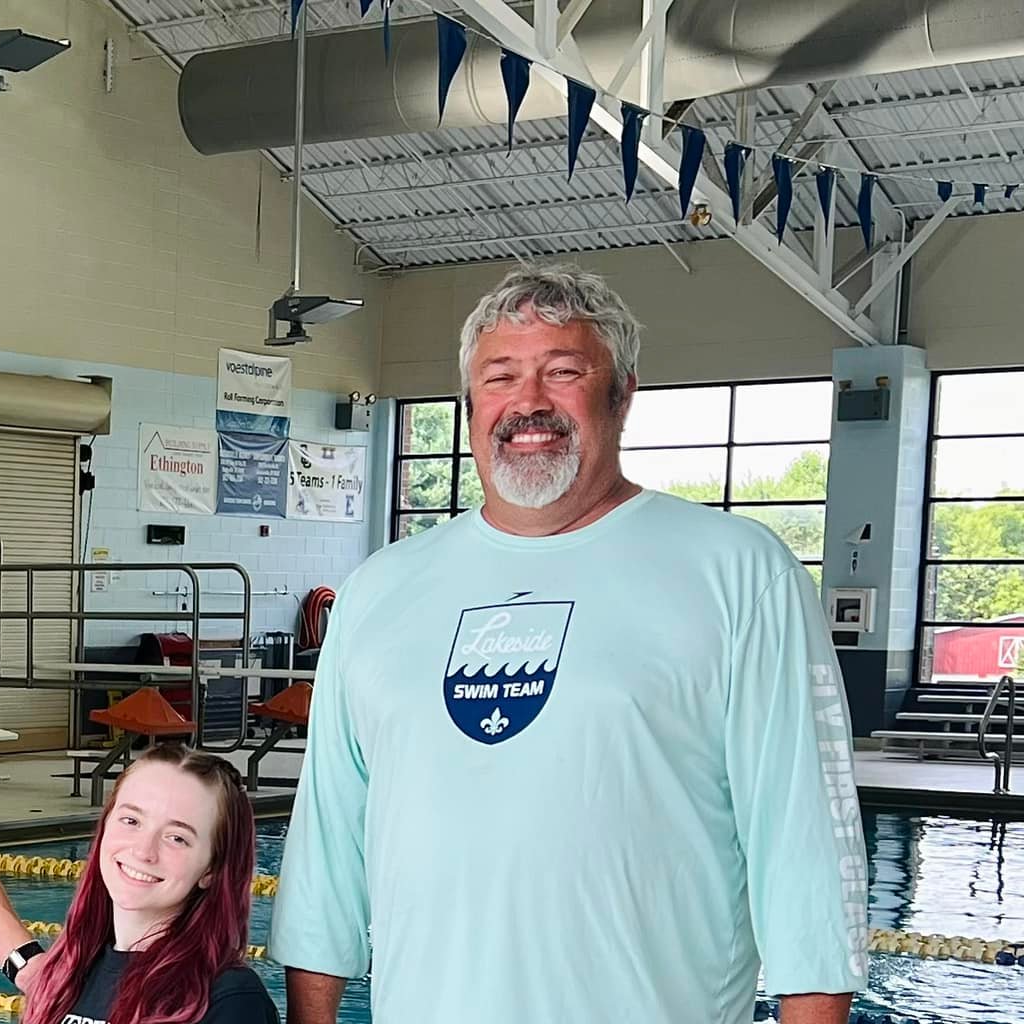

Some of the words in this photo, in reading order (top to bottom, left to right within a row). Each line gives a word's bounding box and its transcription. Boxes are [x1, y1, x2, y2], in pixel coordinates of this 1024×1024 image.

[150, 454, 204, 477] Ethington
[296, 471, 324, 489] Teams
[337, 474, 363, 495] Family
[462, 611, 553, 660] Lakeside
[453, 683, 499, 699] SWIM
[502, 680, 545, 698] TEAM
